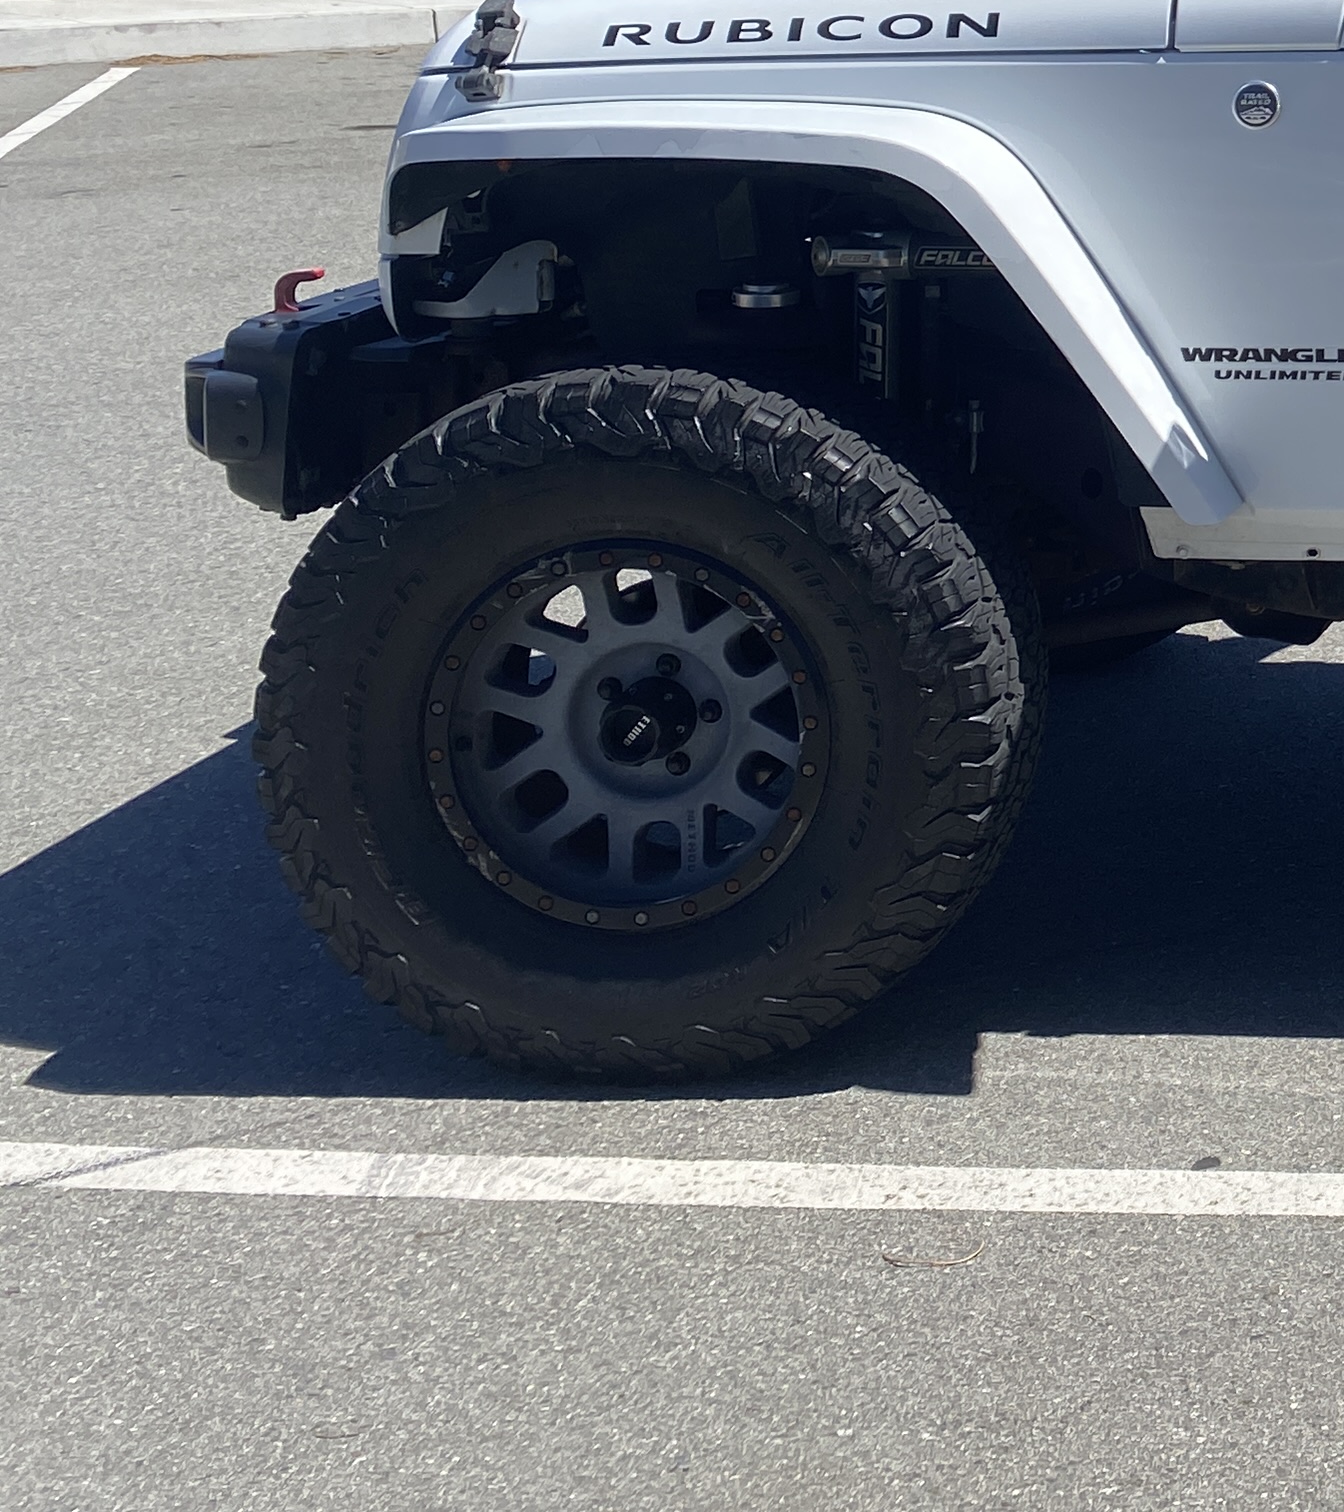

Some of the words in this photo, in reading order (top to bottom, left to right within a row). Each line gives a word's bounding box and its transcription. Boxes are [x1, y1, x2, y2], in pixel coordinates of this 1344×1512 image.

[601, 11, 1001, 47] RUBICON
[1243, 92, 1270, 100] TRAIL
[623, 715, 651, 747] ETHOD
